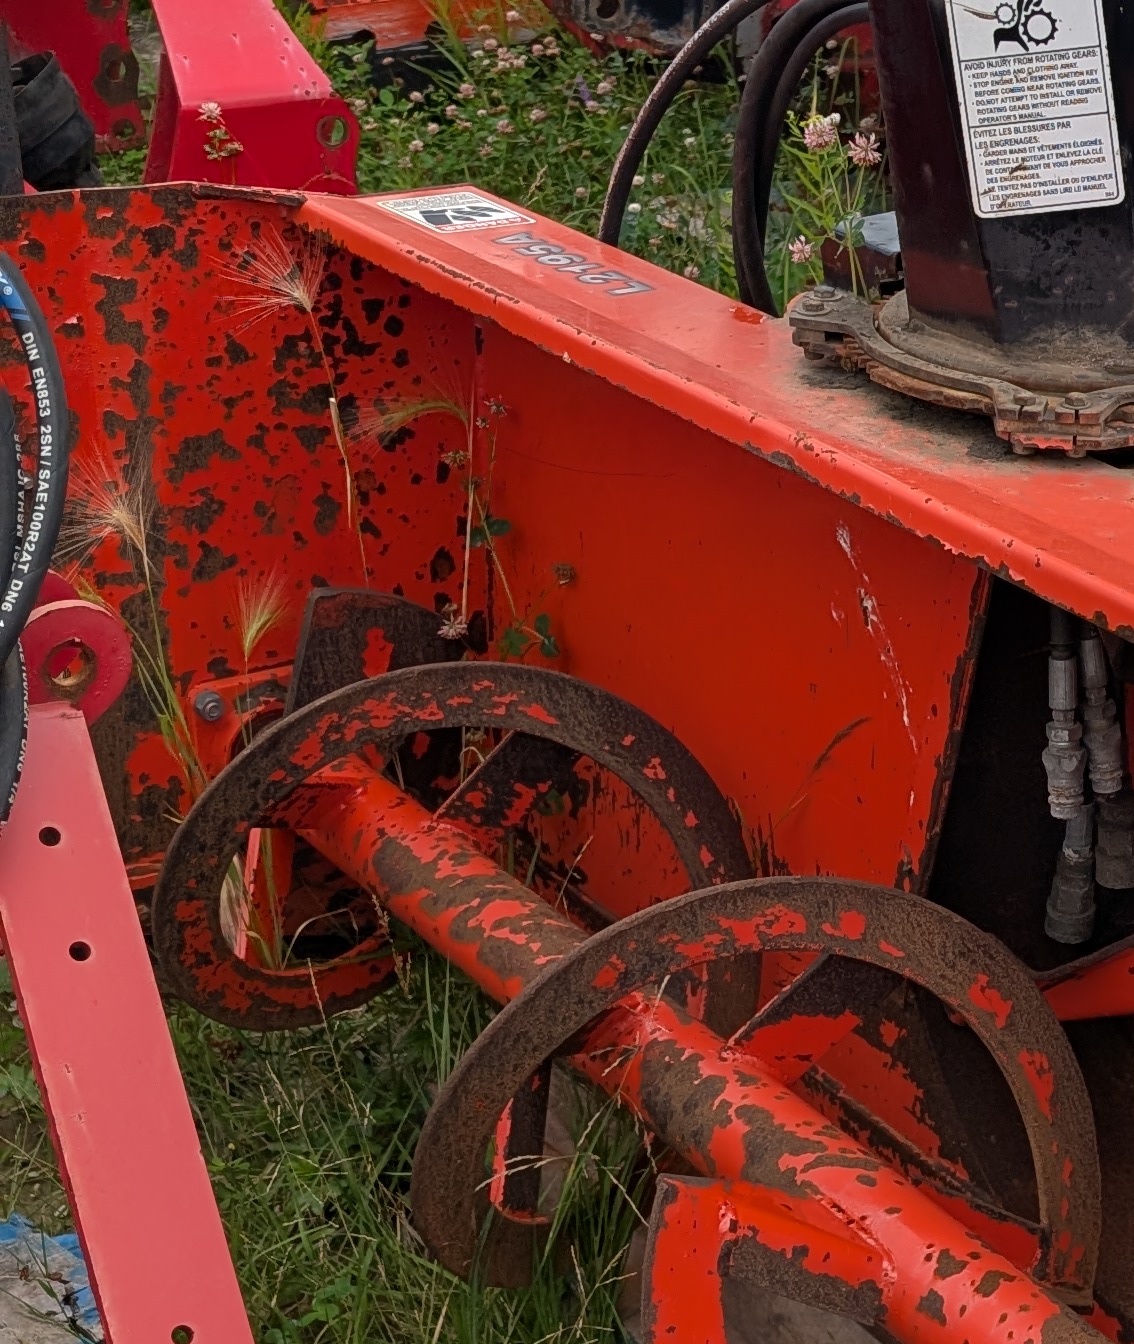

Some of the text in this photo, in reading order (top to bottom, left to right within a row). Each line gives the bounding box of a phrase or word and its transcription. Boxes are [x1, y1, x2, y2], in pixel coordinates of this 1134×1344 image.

[963, 61, 985, 72] AVOID
[986, 58, 1011, 68] INJURY
[1012, 56, 1034, 66] FROM
[1013, 122, 1056, 135] BLESSURES
[1056, 120, 1072, 130] PAR
[490, 231, 656, 297] L2195A
[21, 331, 41, 362] DIN
[32, 366, 51, 419] EN853
[1, 578, 24, 613] DN6
